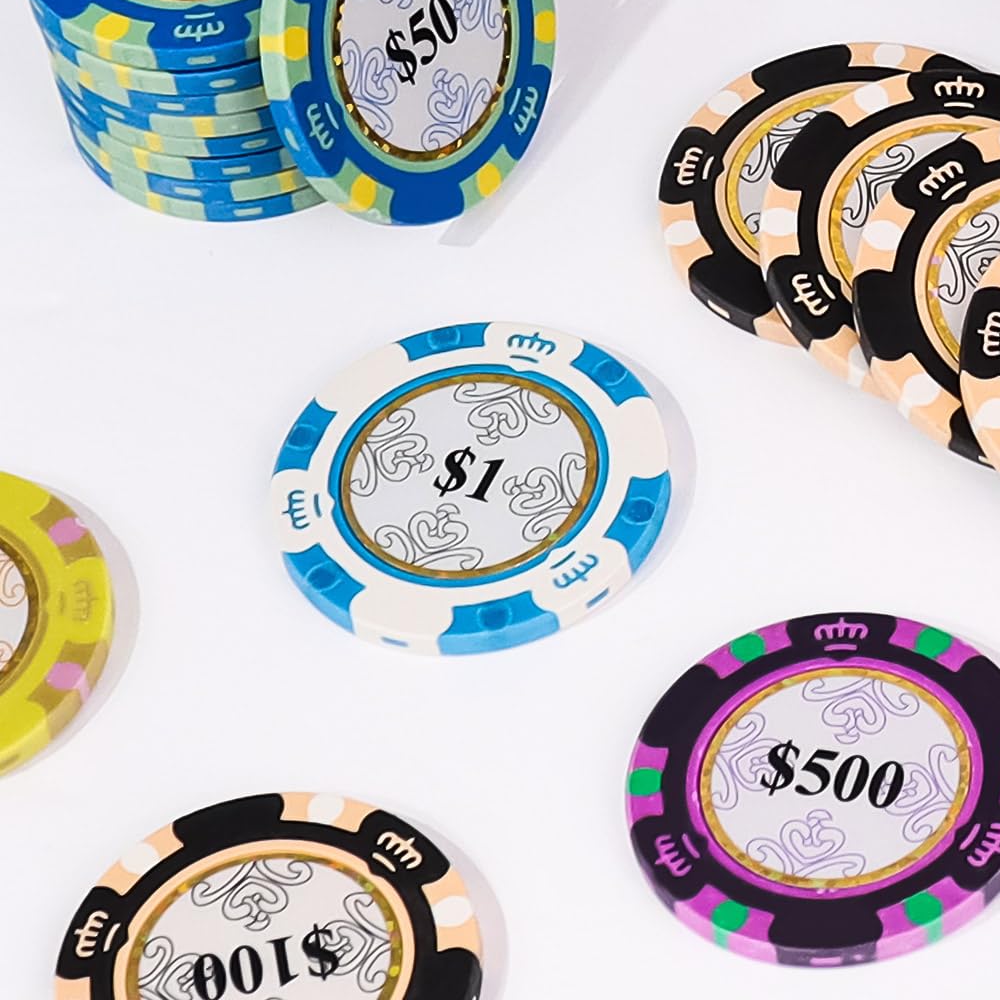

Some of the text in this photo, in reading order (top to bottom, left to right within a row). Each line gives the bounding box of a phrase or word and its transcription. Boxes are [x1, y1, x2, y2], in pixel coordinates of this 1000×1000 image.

[433, 446, 504, 502] $1
[760, 740, 905, 809] $500
[193, 923, 340, 1000] $100
